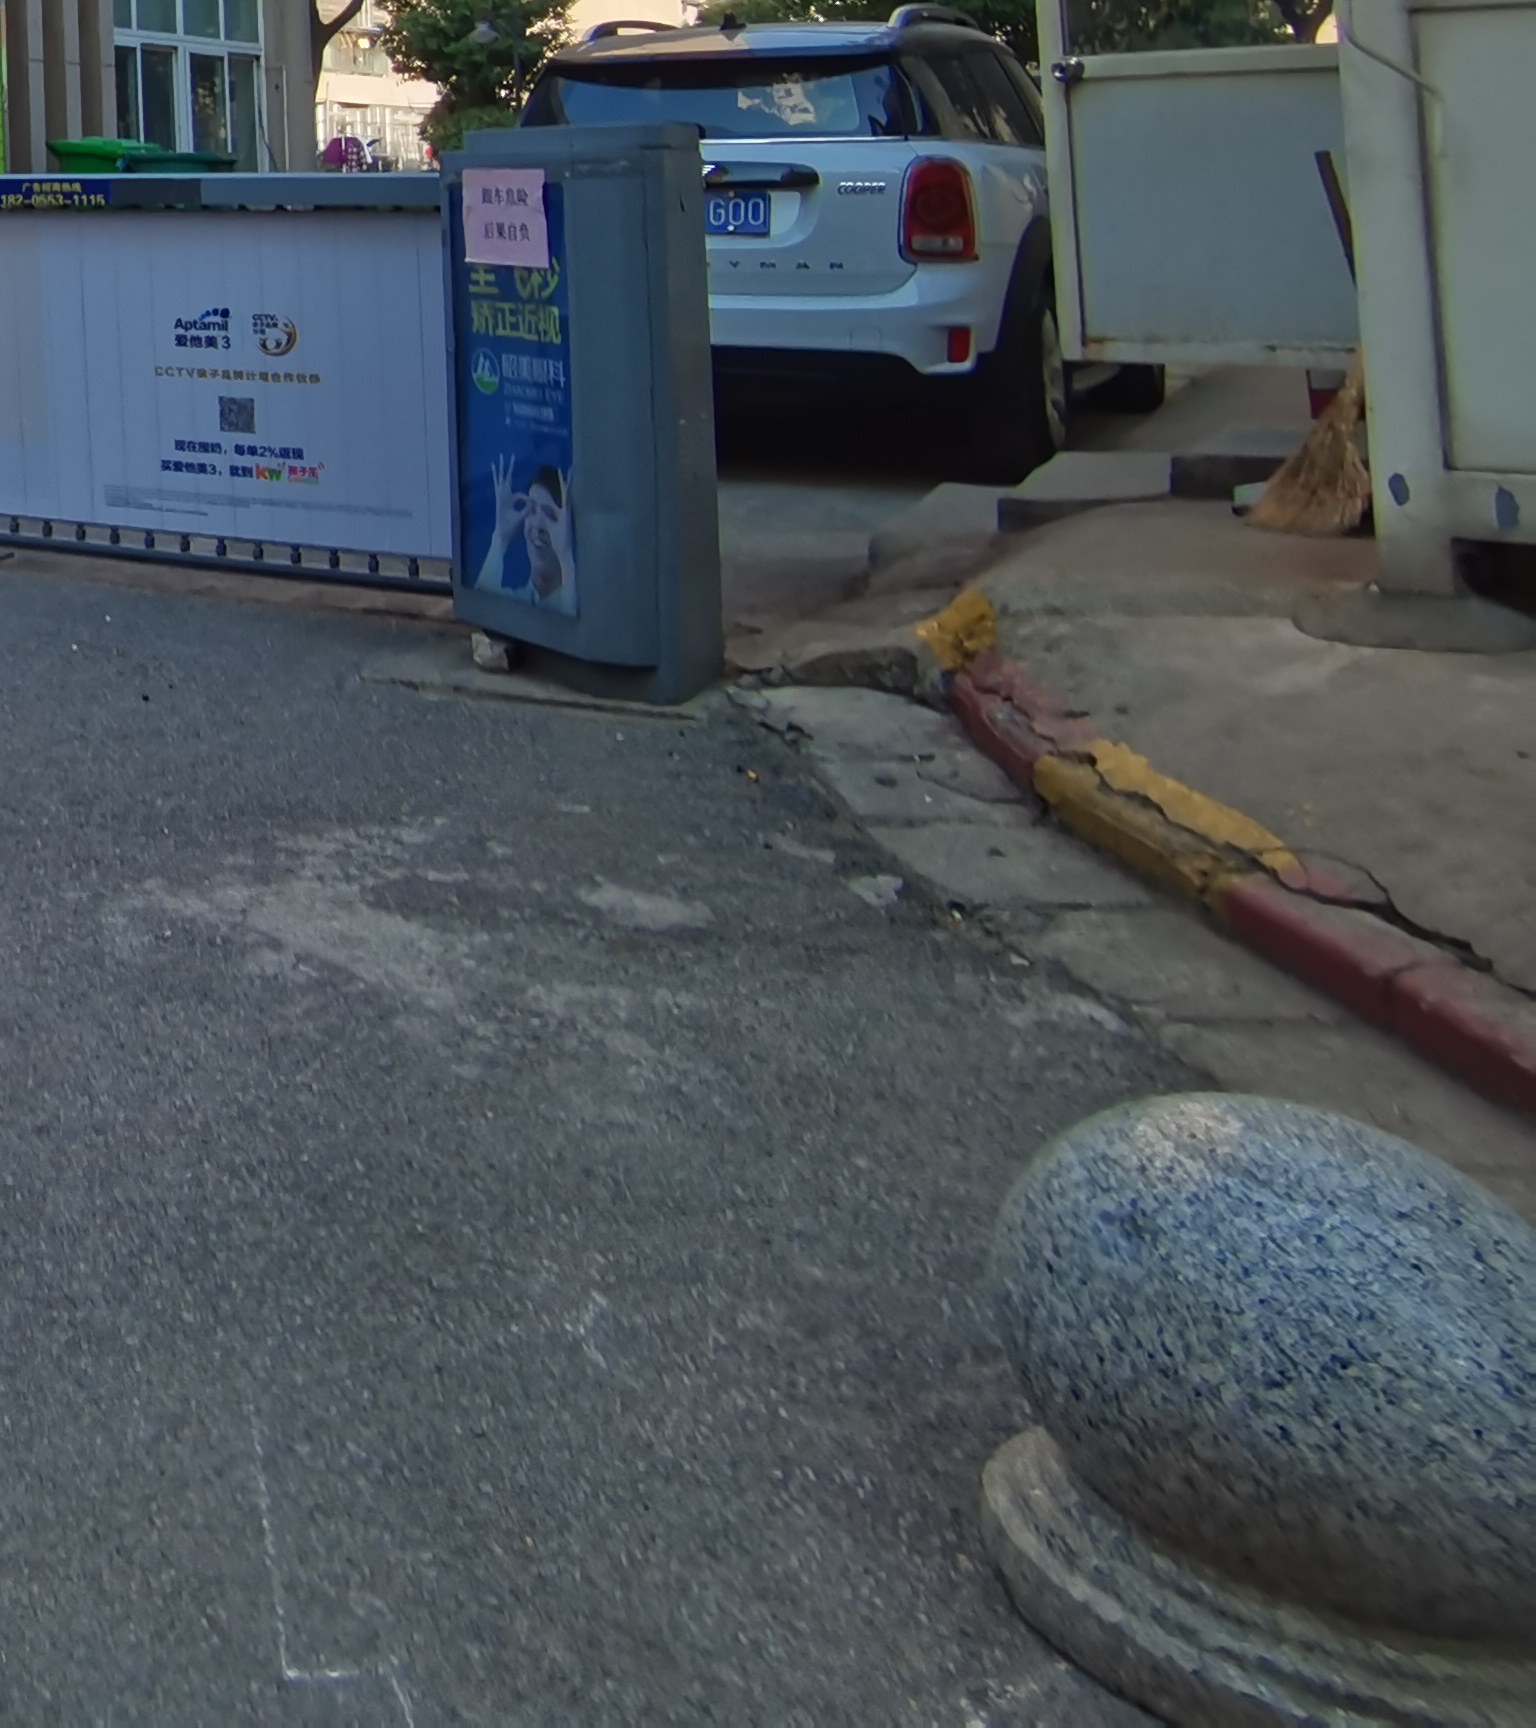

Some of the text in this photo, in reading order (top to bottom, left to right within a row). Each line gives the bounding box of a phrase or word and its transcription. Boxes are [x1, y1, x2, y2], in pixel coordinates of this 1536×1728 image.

[481, 186, 530, 207] 跟车危险
[837, 181, 887, 196] COOPER
[483, 221, 531, 243] 后果自负
[174, 317, 230, 333] Aptamil
[470, 299, 562, 345] 矫正近视
[174, 333, 219, 350] 爱他美
[501, 353, 566, 389] 昭美眼科
